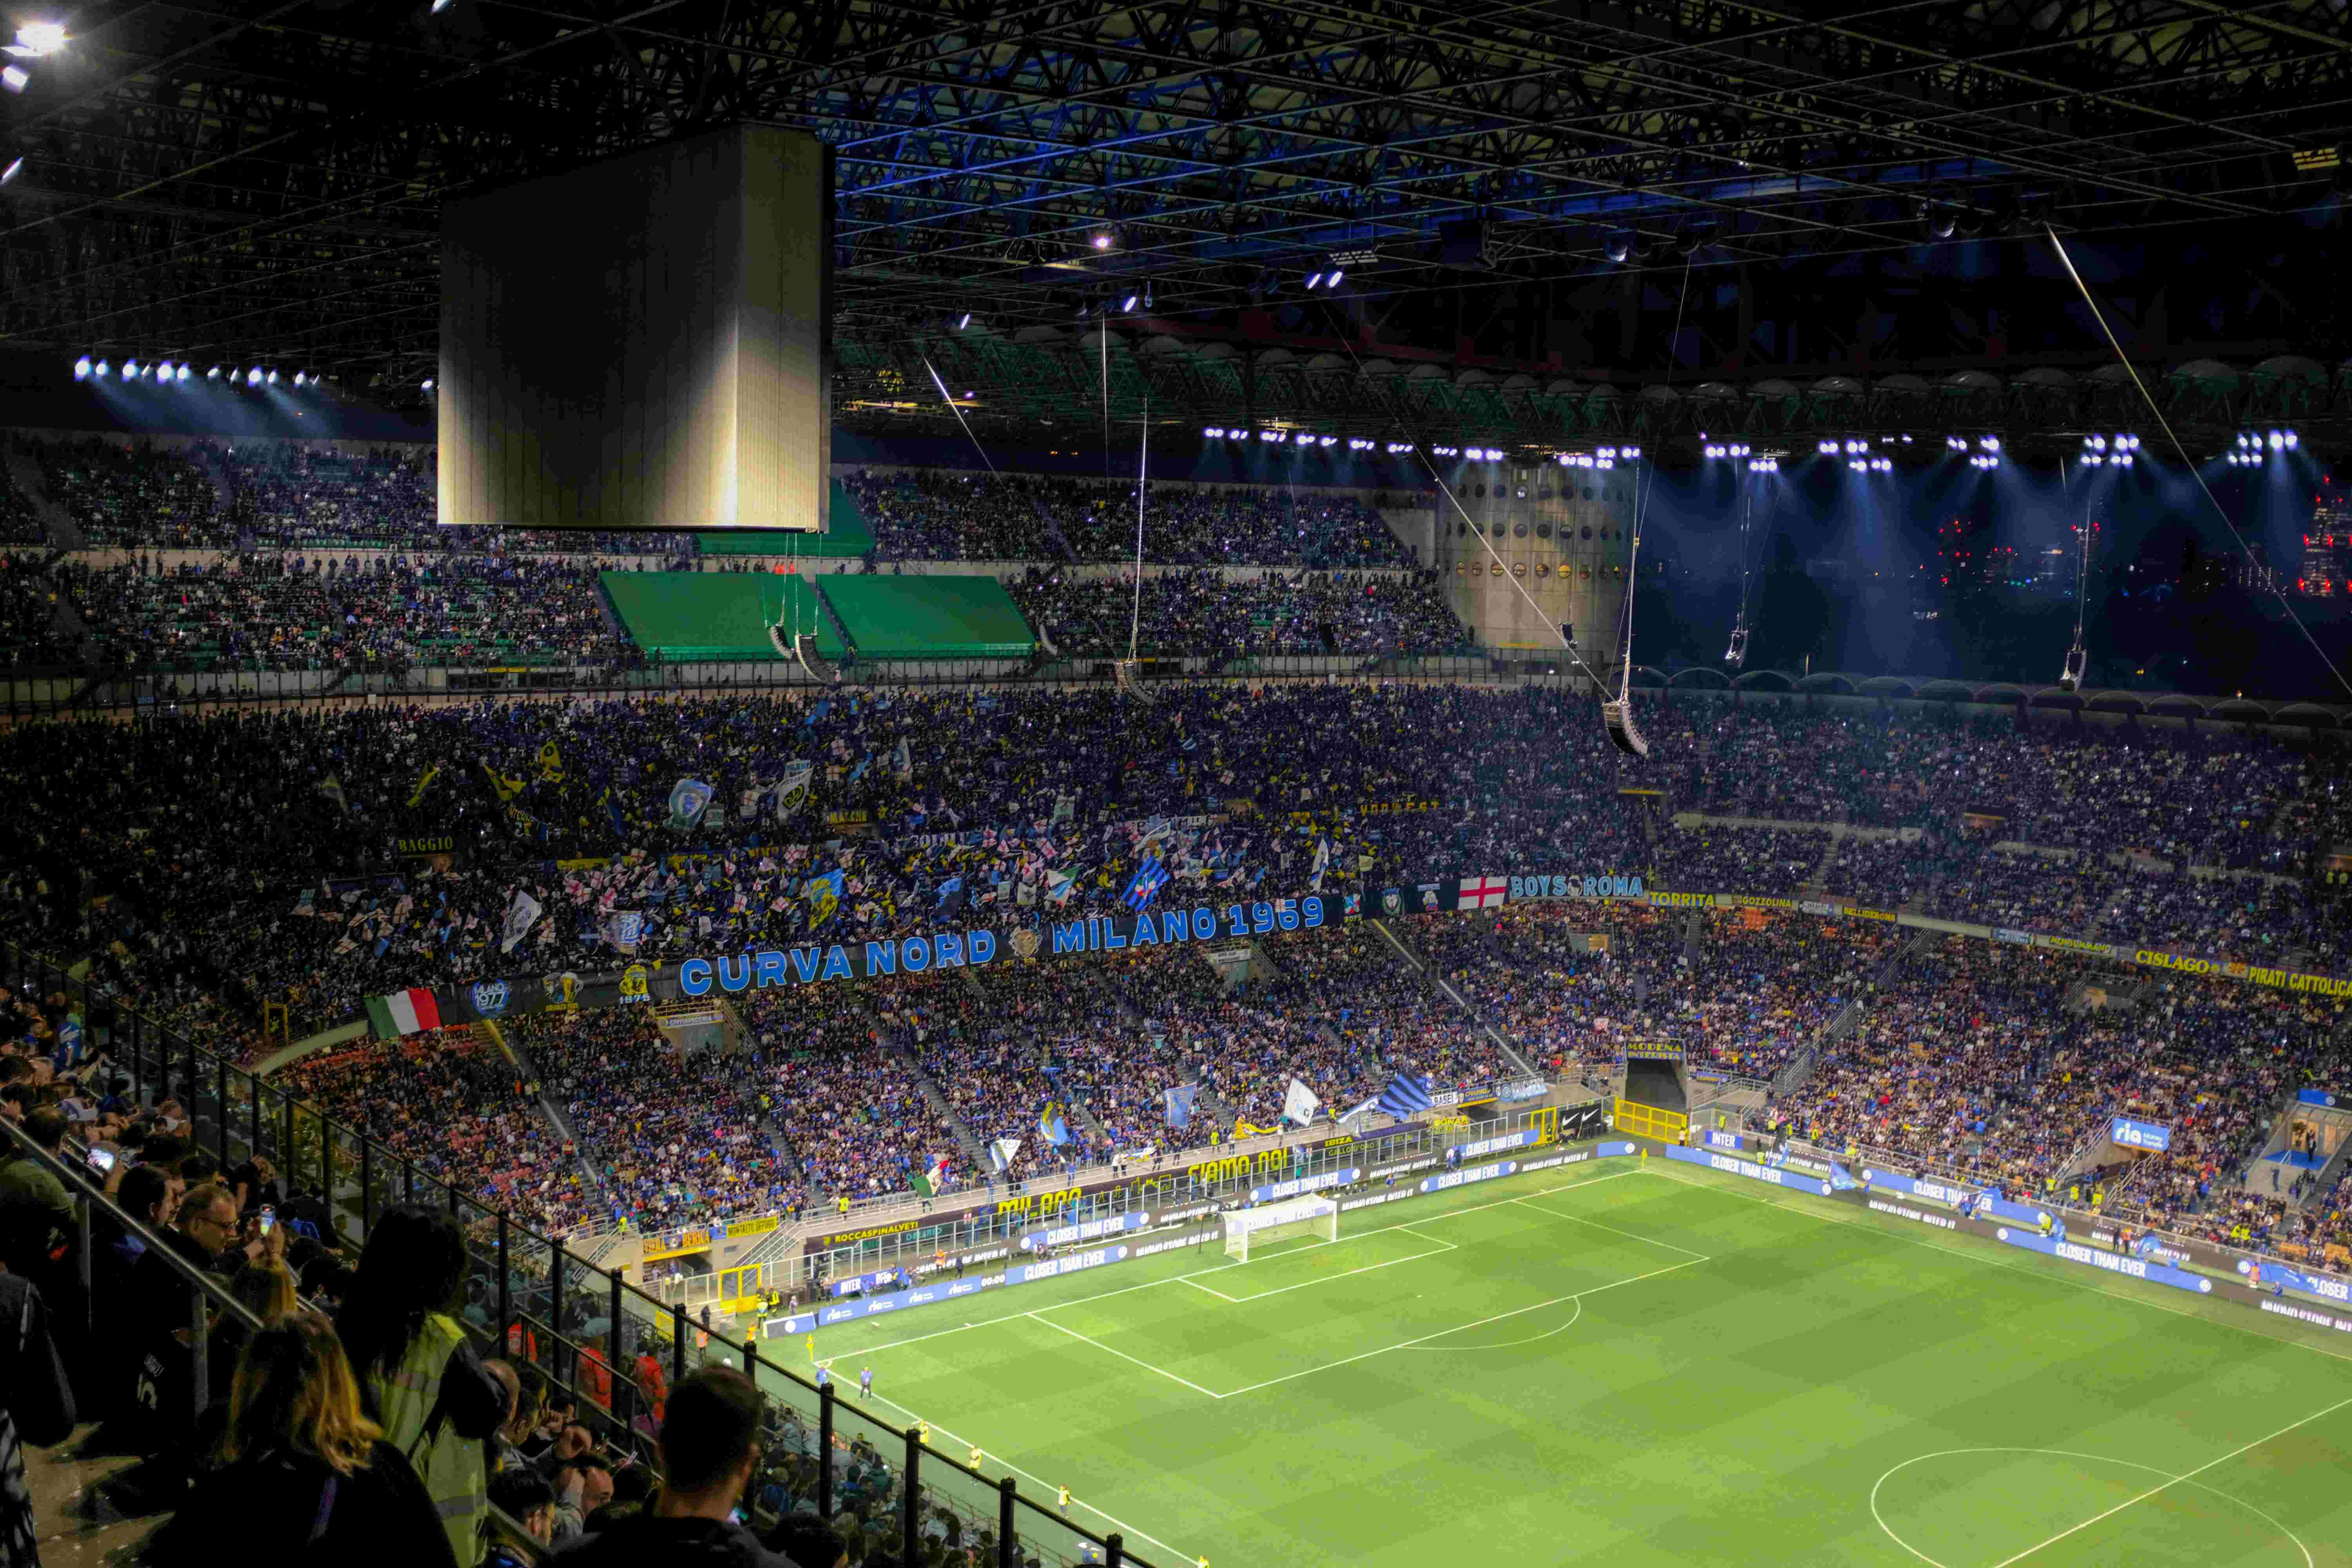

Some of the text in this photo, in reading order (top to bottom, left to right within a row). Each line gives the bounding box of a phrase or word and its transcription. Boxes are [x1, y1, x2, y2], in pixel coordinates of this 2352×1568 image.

[398, 837, 452, 853] BAGGIO
[1511, 876, 1643, 897] BOYS ROMA
[1650, 892, 1715, 907] TORRITA
[1742, 897, 1792, 908] GOZZOLINA
[1052, 897, 1323, 953] MILANO 1969
[681, 930, 996, 996] CURVA NORD
[2136, 950, 2210, 973] CISLAGO
[2249, 965, 2352, 996] PIRATI CATTOLICA
[475, 992, 505, 1007] 1977
[1628, 1043, 1681, 1052] MODENA
[1324, 1135, 1354, 1147] IBIZA
[1467, 1133, 1523, 1156] CLOSER THAN EVER
[1712, 1132, 1735, 1148] INTER
[2116, 1123, 2141, 1144] ria
[1258, 1147, 1288, 1173] NOI
[1712, 1154, 1739, 1173] CLOSER
[1741, 1160, 1760, 1178] THAN
[1762, 1167, 1781, 1183] EVER
[1273, 1172, 1339, 1198] CLOSER THAN EVER
[1438, 1164, 1499, 1188] CLOSER THAN EVER
[998, 1187, 1082, 1218] MILANO
[1913, 1180, 1944, 1200] CLOSER
[1947, 1189, 1963, 1205] THA
[834, 1221, 918, 1243] ROCCASPINALVETI
[1047, 1217, 1124, 1245] CLOSER THAN EVER
[1025, 1260, 1057, 1280] CLOSER
[1059, 1254, 1081, 1273] THAN
[1084, 1250, 1105, 1269] EVER
[2056, 1243, 2092, 1263] CLOSER
[2094, 1250, 2120, 1271] THAN
[2121, 1258, 2145, 1278] EVER
[840, 1278, 861, 1294] INTER
[981, 1274, 1005, 1287] 00:00
